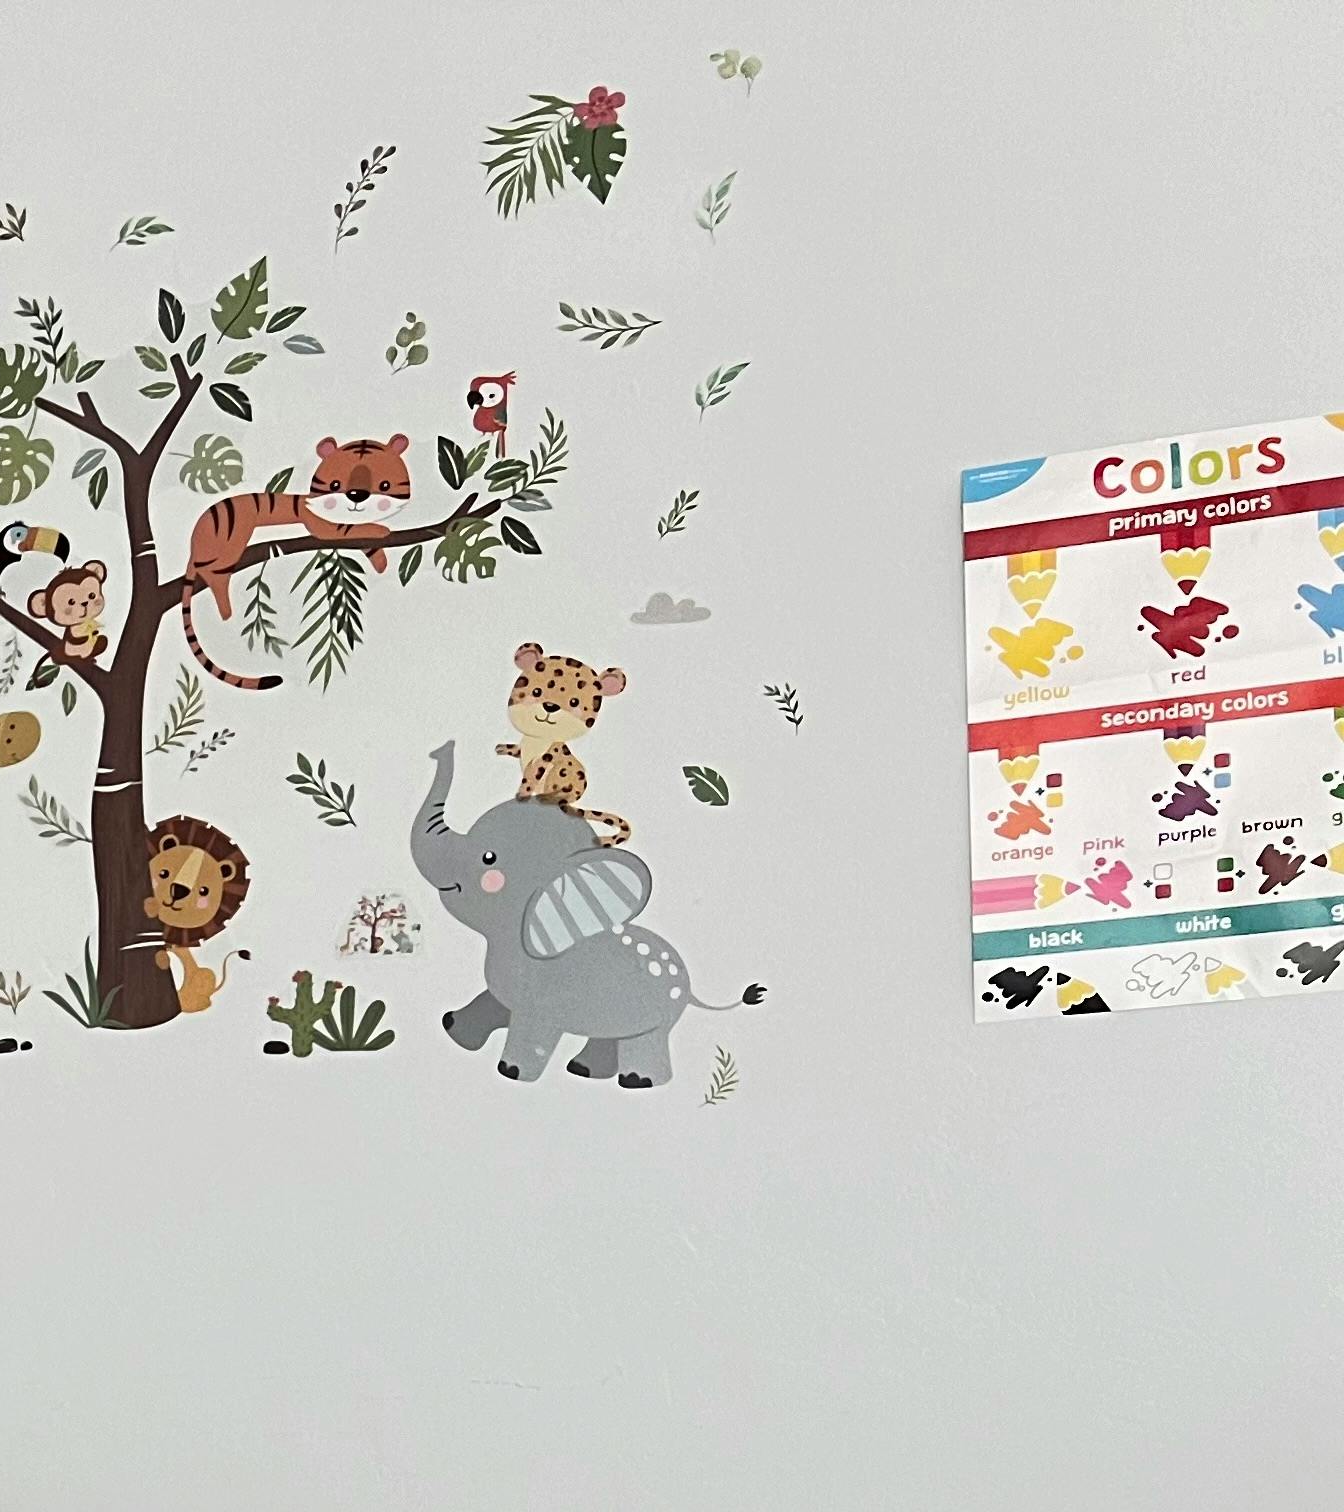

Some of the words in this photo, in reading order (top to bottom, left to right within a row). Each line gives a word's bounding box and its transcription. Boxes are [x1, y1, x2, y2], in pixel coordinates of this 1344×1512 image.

[1093, 436, 1286, 498] Colors
[1109, 505, 1198, 537] primary
[1203, 494, 1272, 519] colors
[1170, 666, 1206, 685] red
[1004, 685, 1070, 711] yellow
[1100, 700, 1215, 729] secondary
[1221, 689, 1289, 713] colors
[1241, 816, 1304, 834] brown
[1082, 836, 1125, 856] pink
[1158, 825, 1217, 847] purple
[991, 843, 1054, 863] orange
[1176, 915, 1232, 934] white
[1028, 929, 1084, 949] black
